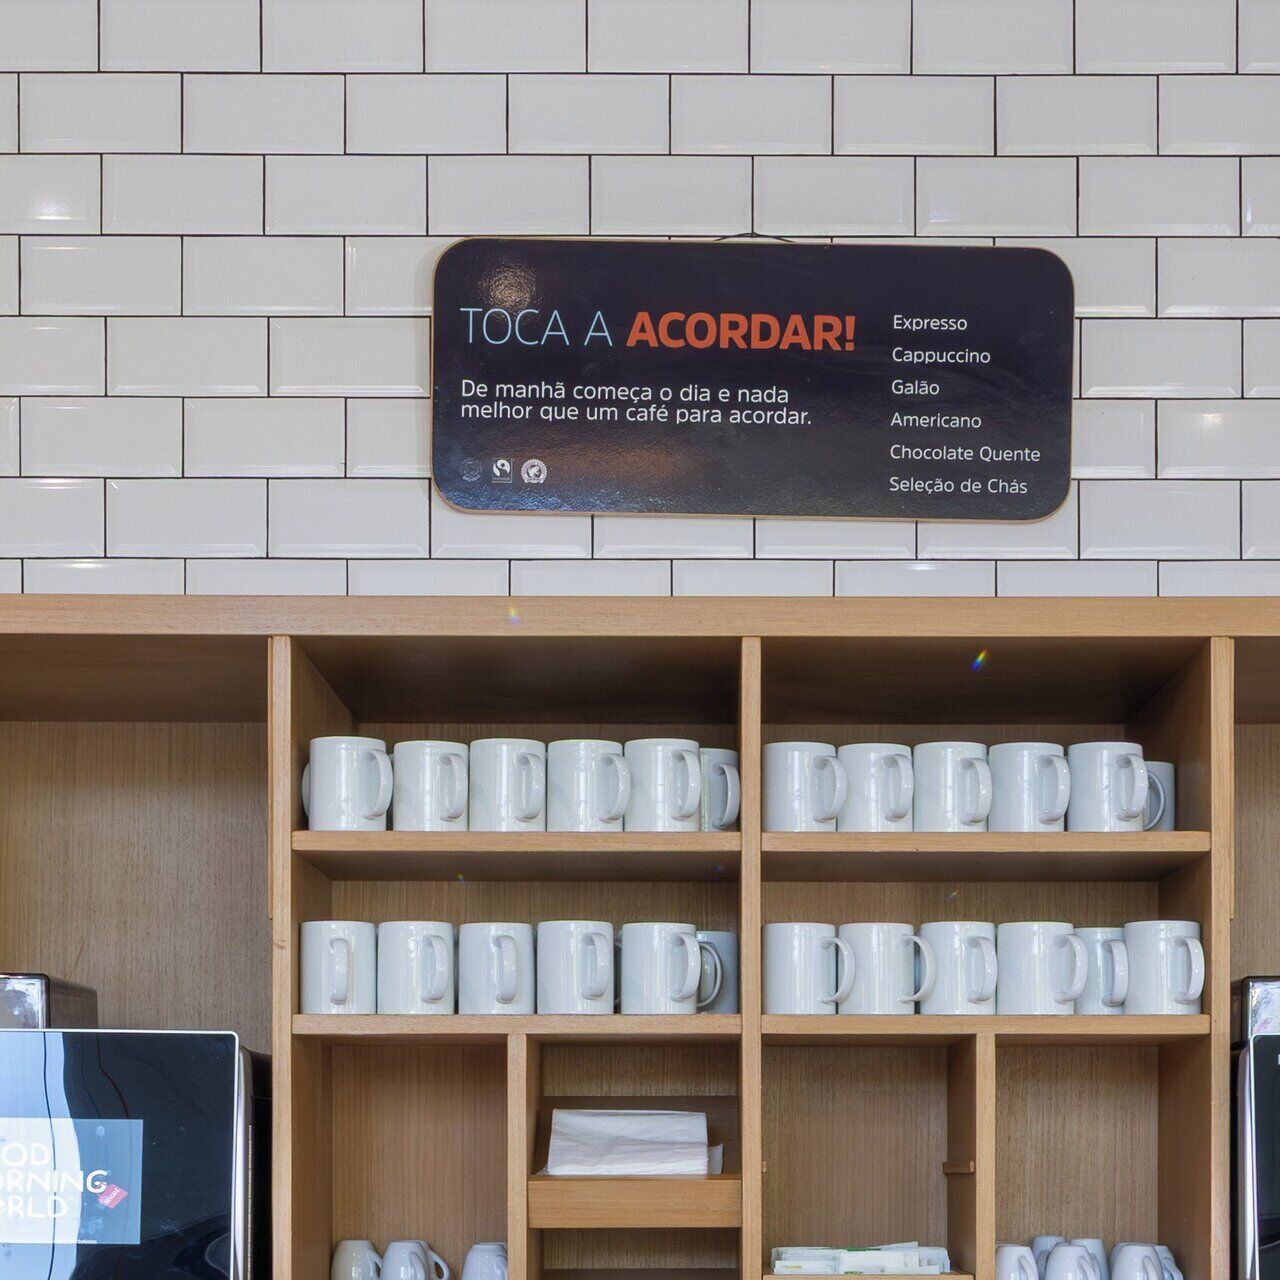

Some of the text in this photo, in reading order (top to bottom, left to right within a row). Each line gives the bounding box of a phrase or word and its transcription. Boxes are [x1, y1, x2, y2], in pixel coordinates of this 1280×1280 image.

[460, 308, 855, 350] TOCA A ACORDAR!
[894, 315, 967, 331] Expresso
[893, 347, 990, 364] Cappuccino
[462, 380, 788, 403] De manhã começa o dia e nada
[892, 380, 939, 395] Galão
[462, 401, 811, 424] melhor que um café para acordar.
[891, 413, 981, 428] Americano
[891, 445, 1040, 462] Chocolate Quente
[890, 477, 1027, 494] Seleção de Chás
